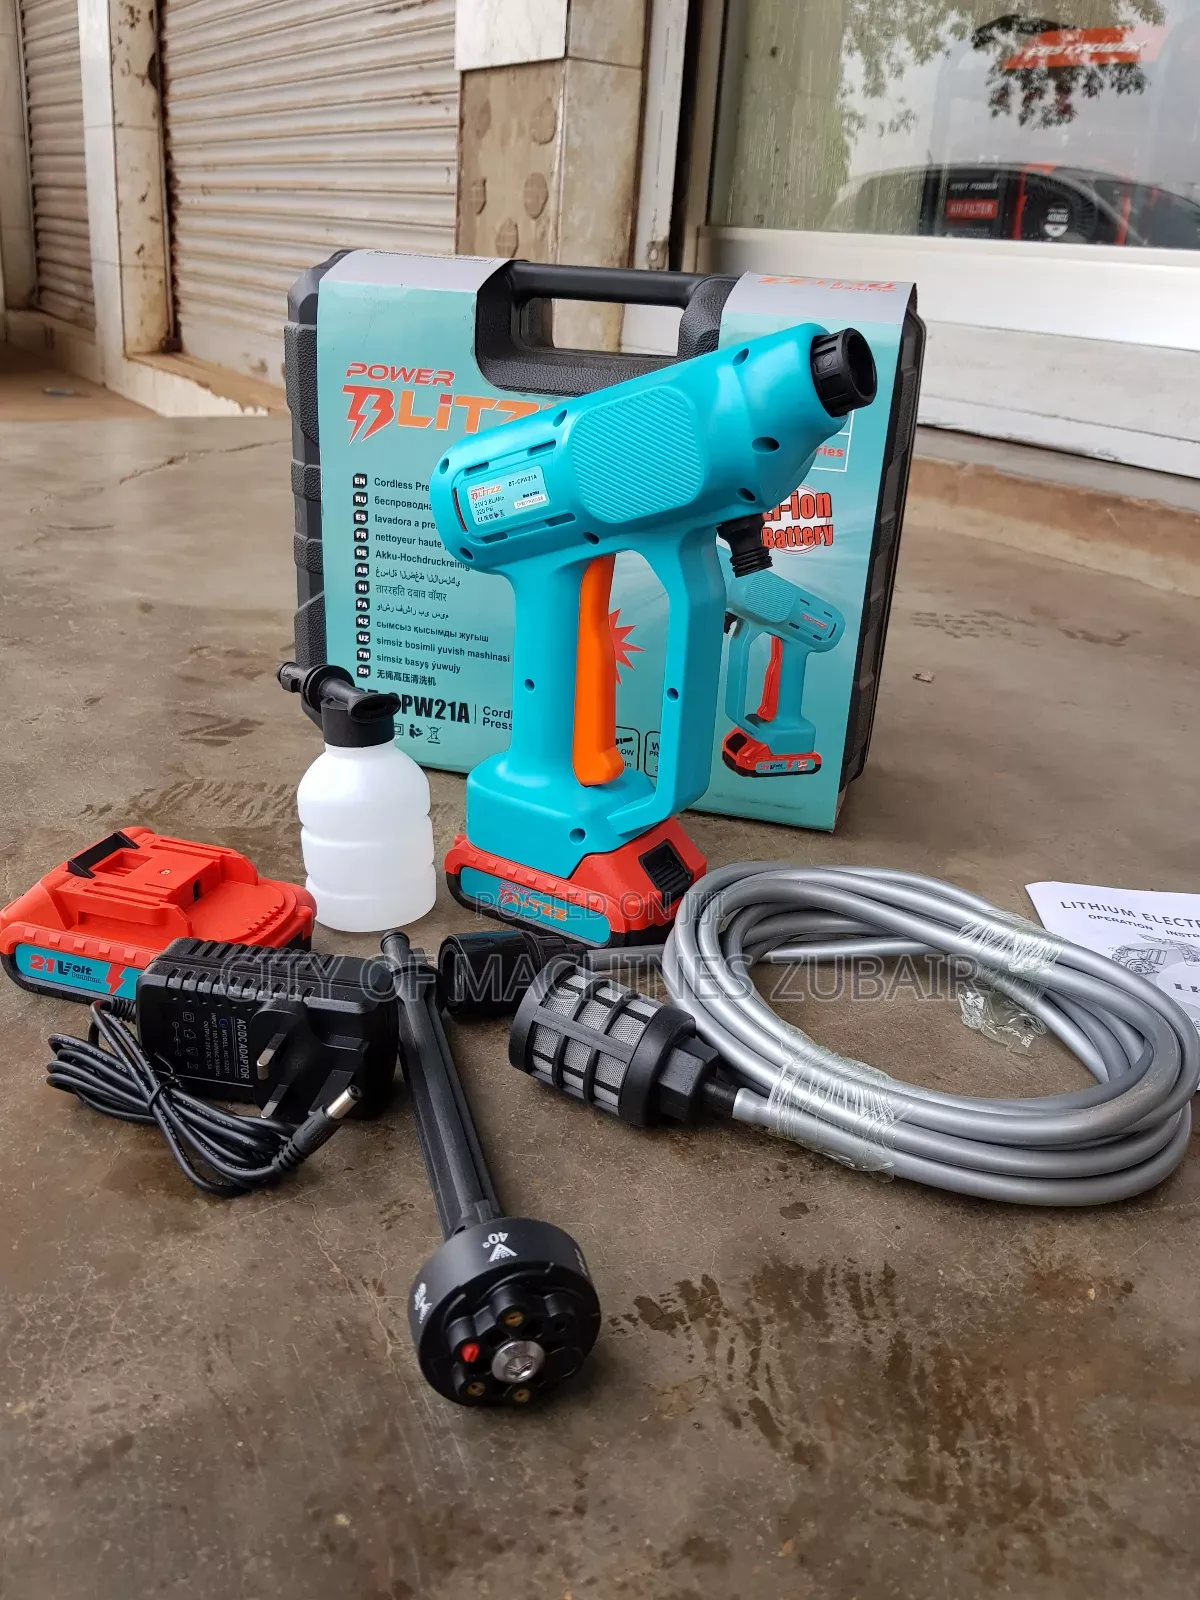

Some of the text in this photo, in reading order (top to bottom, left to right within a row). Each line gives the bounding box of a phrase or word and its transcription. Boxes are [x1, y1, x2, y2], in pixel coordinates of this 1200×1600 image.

[346, 362, 455, 387] POWER
[816, 445, 844, 457] ries
[354, 477, 430, 492] EN Cordless Pre
[355, 496, 432, 511] RU беспроводна
[355, 513, 366, 521] ES
[374, 513, 412, 527] lavadora
[421, 522, 438, 530] pre
[356, 531, 442, 548] FR nettoyeur haute
[762, 524, 834, 549] Battery
[356, 549, 470, 571] DE Akku-Hochdruckreinig
[376, 621, 412, 632] сымсыз
[358, 634, 369, 642] UZ
[405, 640, 435, 652] bosimli
[437, 646, 465, 656] yuvish
[467, 650, 510, 663] mashinasi
[358, 651, 370, 659] TM
[376, 669, 436, 687] 无绳高压清洗机
[482, 706, 513, 719] Cordl
[482, 717, 512, 731] Press
[1060, 901, 1136, 918] LITHIUM
[1088, 914, 1200, 938] OPERATION INSTR
[29, 954, 56, 973] 21
[237, 1018, 250, 1079] AC/DC ADAPTOR
[483, 1232, 509, 1248] 40°
